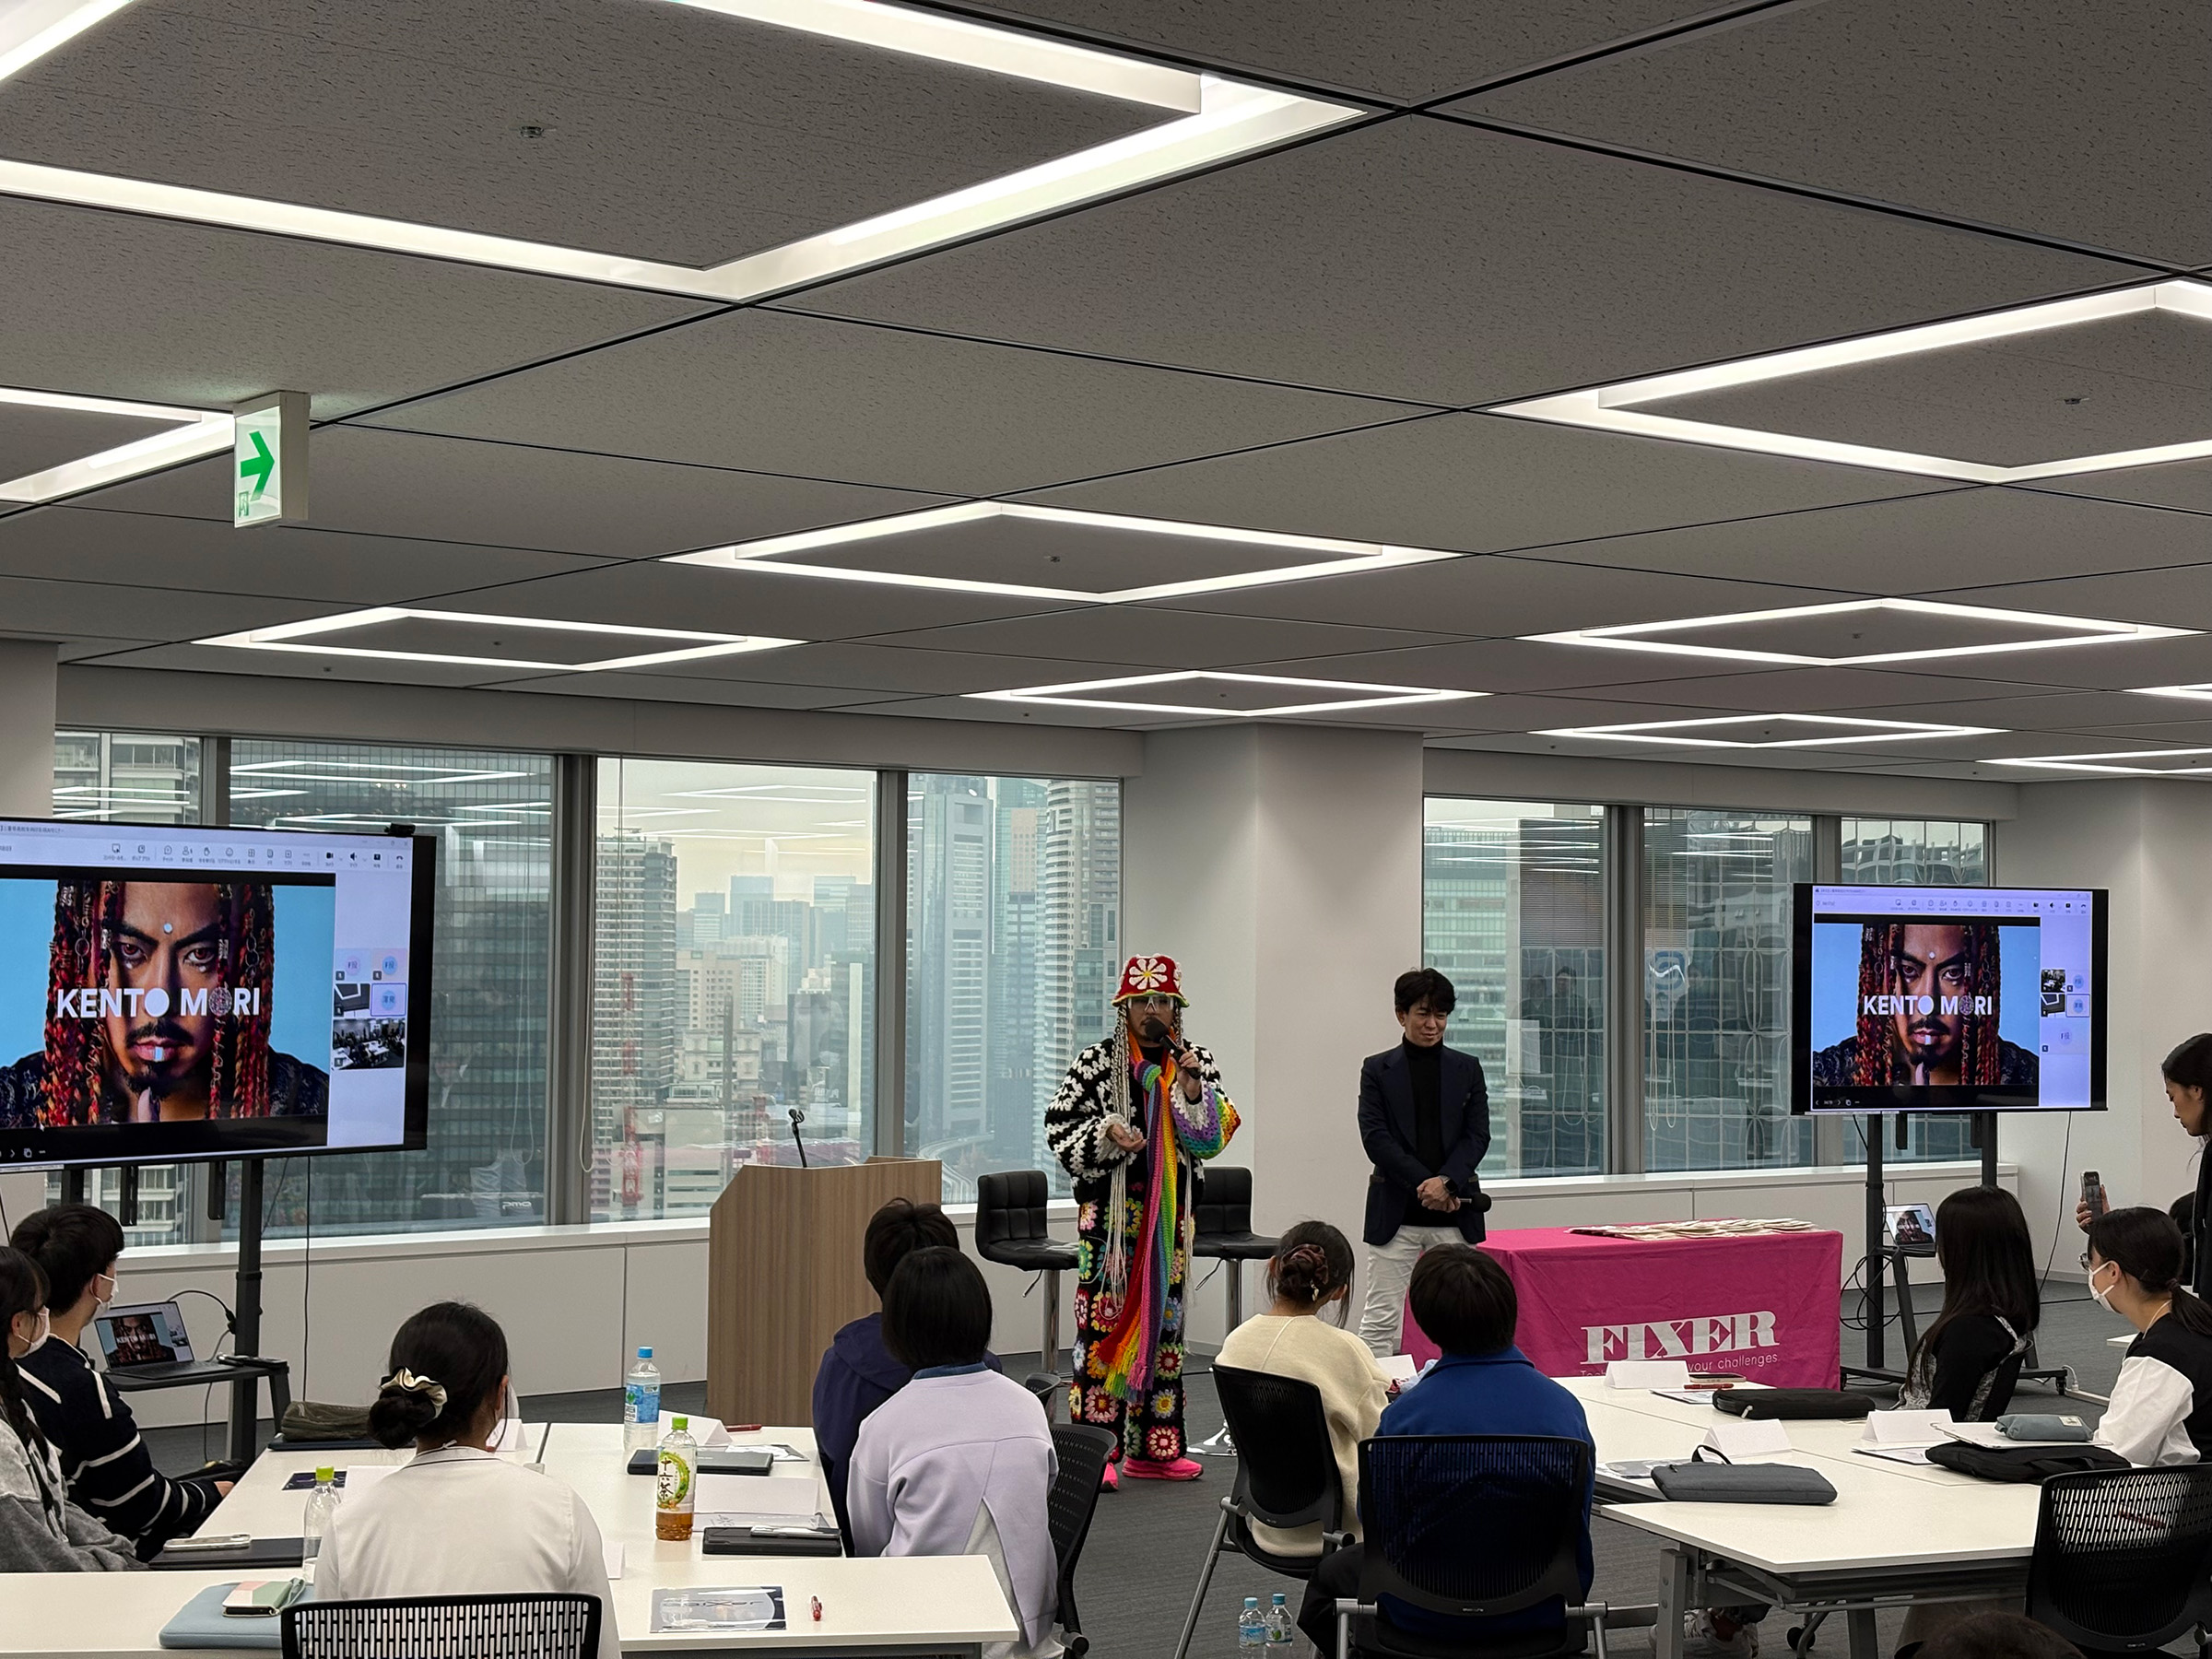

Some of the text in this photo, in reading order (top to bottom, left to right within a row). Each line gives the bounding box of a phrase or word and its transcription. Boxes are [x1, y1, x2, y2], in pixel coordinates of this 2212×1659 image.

[57, 986, 261, 1018] KENTO MORI
[1864, 994, 1993, 1016] KENTO MORI
[1580, 1310, 1780, 1366] FIXER
[1717, 1352, 1779, 1370] challenges
[659, 1457, 674, 1501] 十六茶
